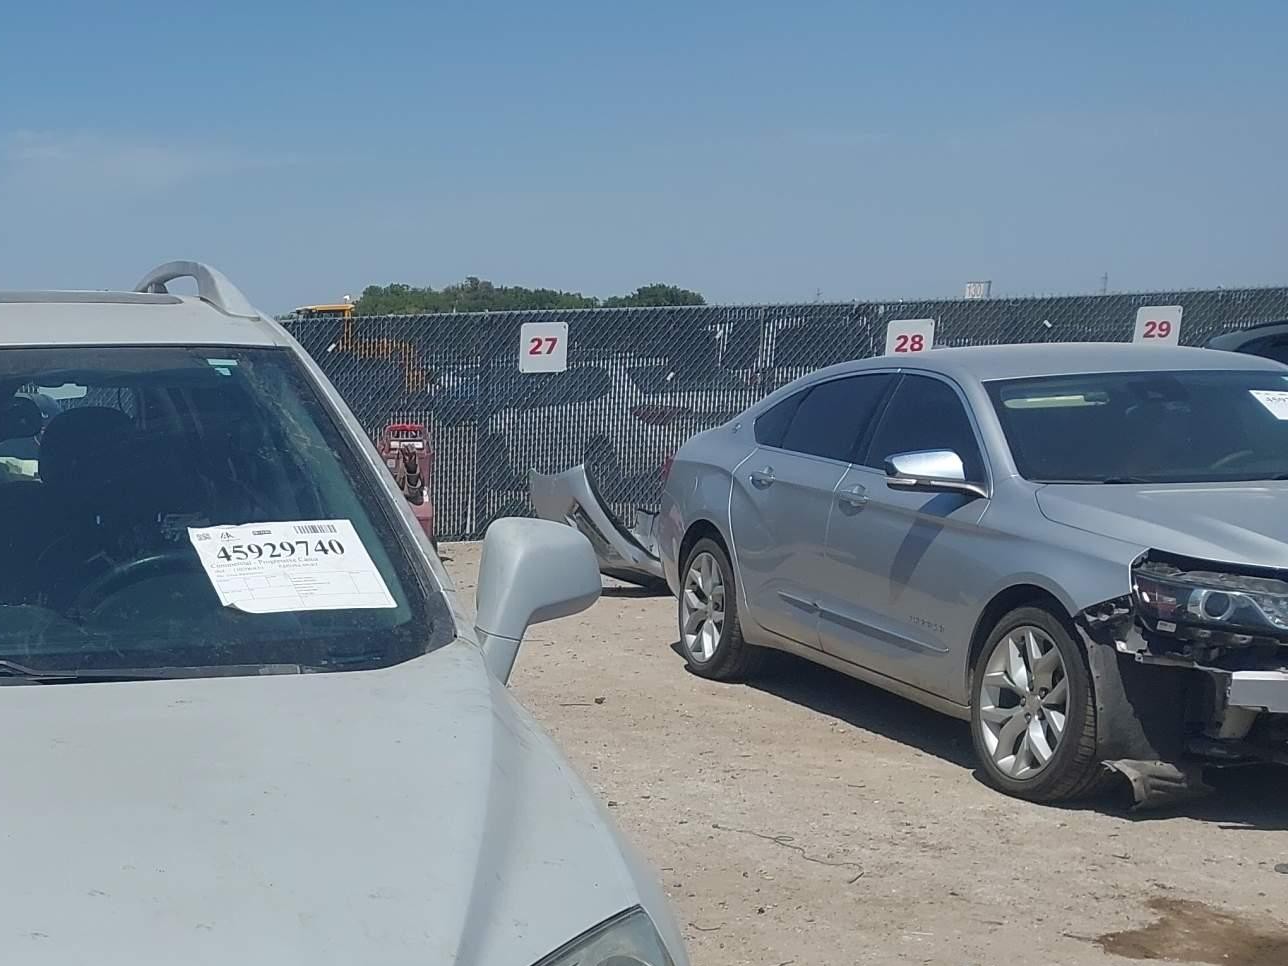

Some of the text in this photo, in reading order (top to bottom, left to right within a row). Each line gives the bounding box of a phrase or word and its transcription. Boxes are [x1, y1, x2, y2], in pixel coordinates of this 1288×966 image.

[1142, 320, 1172, 338] 29
[528, 337, 558, 355] 27
[895, 334, 924, 353] 28
[216, 538, 345, 562] 45929740
